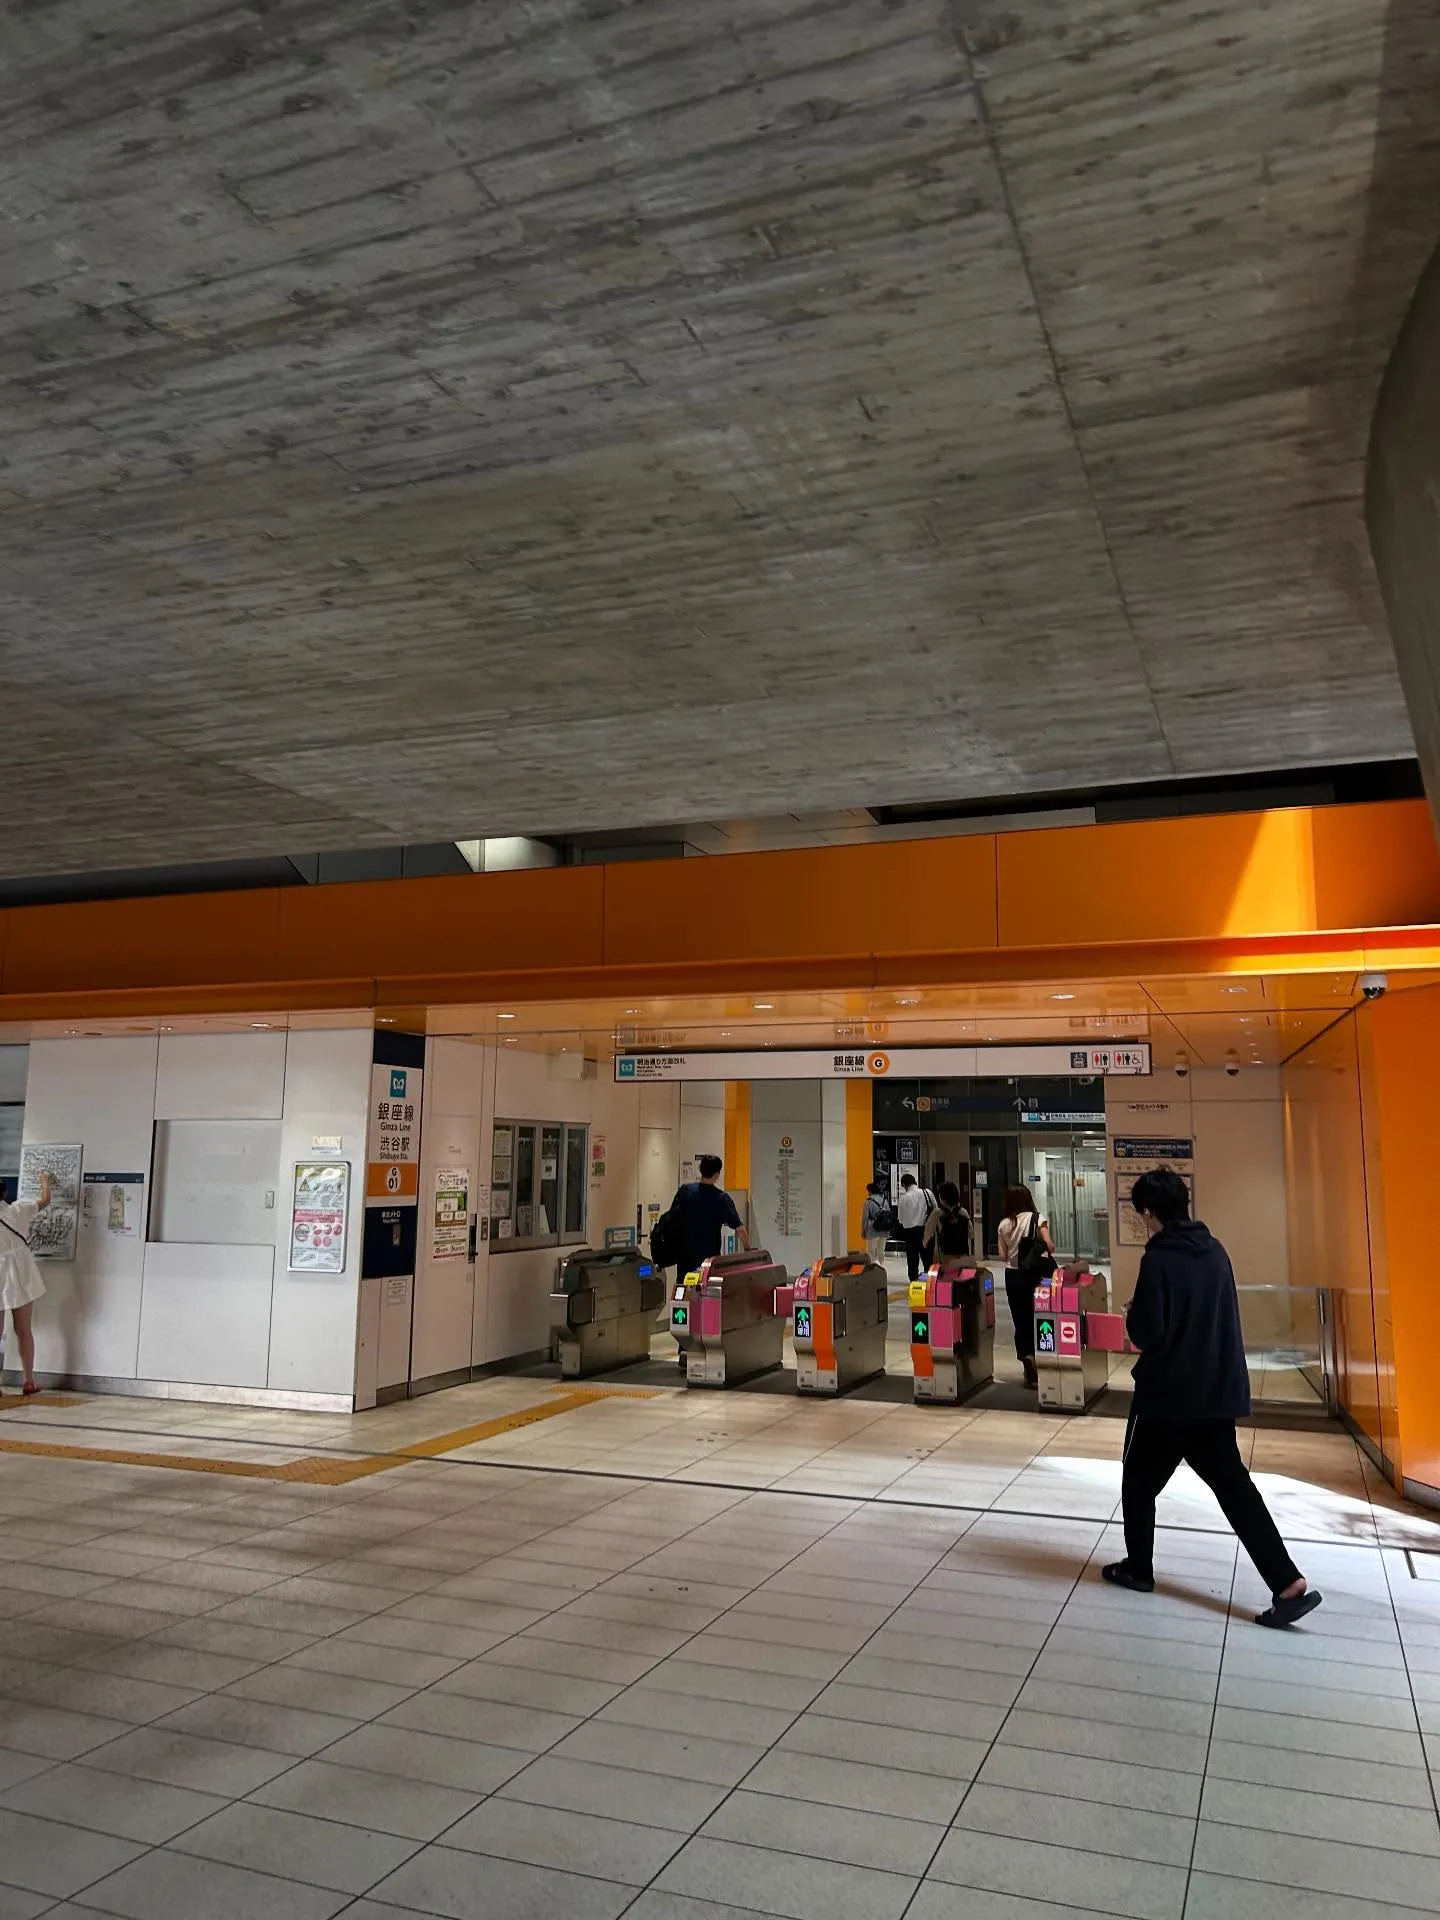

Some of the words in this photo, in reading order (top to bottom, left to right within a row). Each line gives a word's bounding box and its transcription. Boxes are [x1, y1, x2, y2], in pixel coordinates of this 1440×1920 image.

[833, 1055, 865, 1066] 銀座線
[378, 1102, 414, 1121] 銀座線
[380, 1121, 398, 1131] Ginza
[399, 1122, 411, 1131] Line
[380, 1136, 410, 1152] 渋谷駅
[379, 1152, 399, 1161] Shibuya
[391, 1167, 397, 1177] G
[388, 1178, 398, 1189] 01
